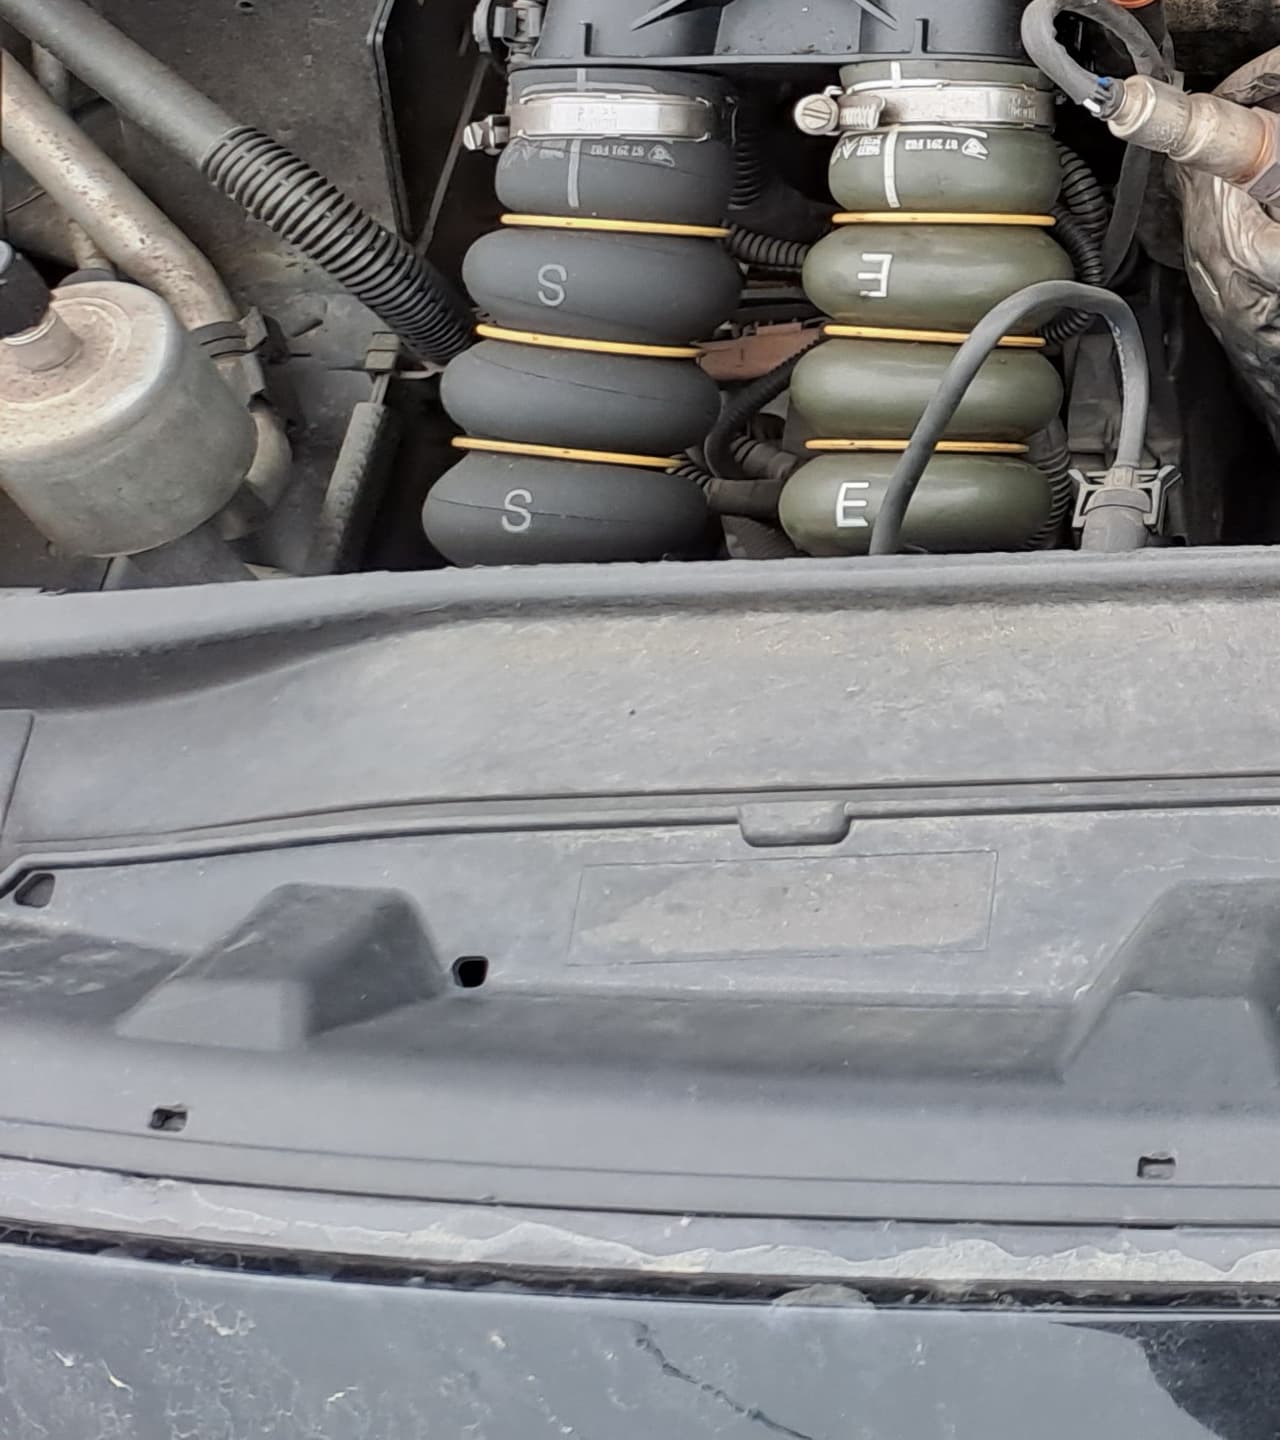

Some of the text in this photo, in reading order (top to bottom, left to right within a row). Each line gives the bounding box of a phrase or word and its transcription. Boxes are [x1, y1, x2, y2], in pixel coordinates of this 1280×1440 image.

[926, 139, 944, 151] 291
[537, 263, 568, 307] S
[857, 252, 894, 298] E
[501, 488, 533, 533] S
[835, 481, 871, 528] E
